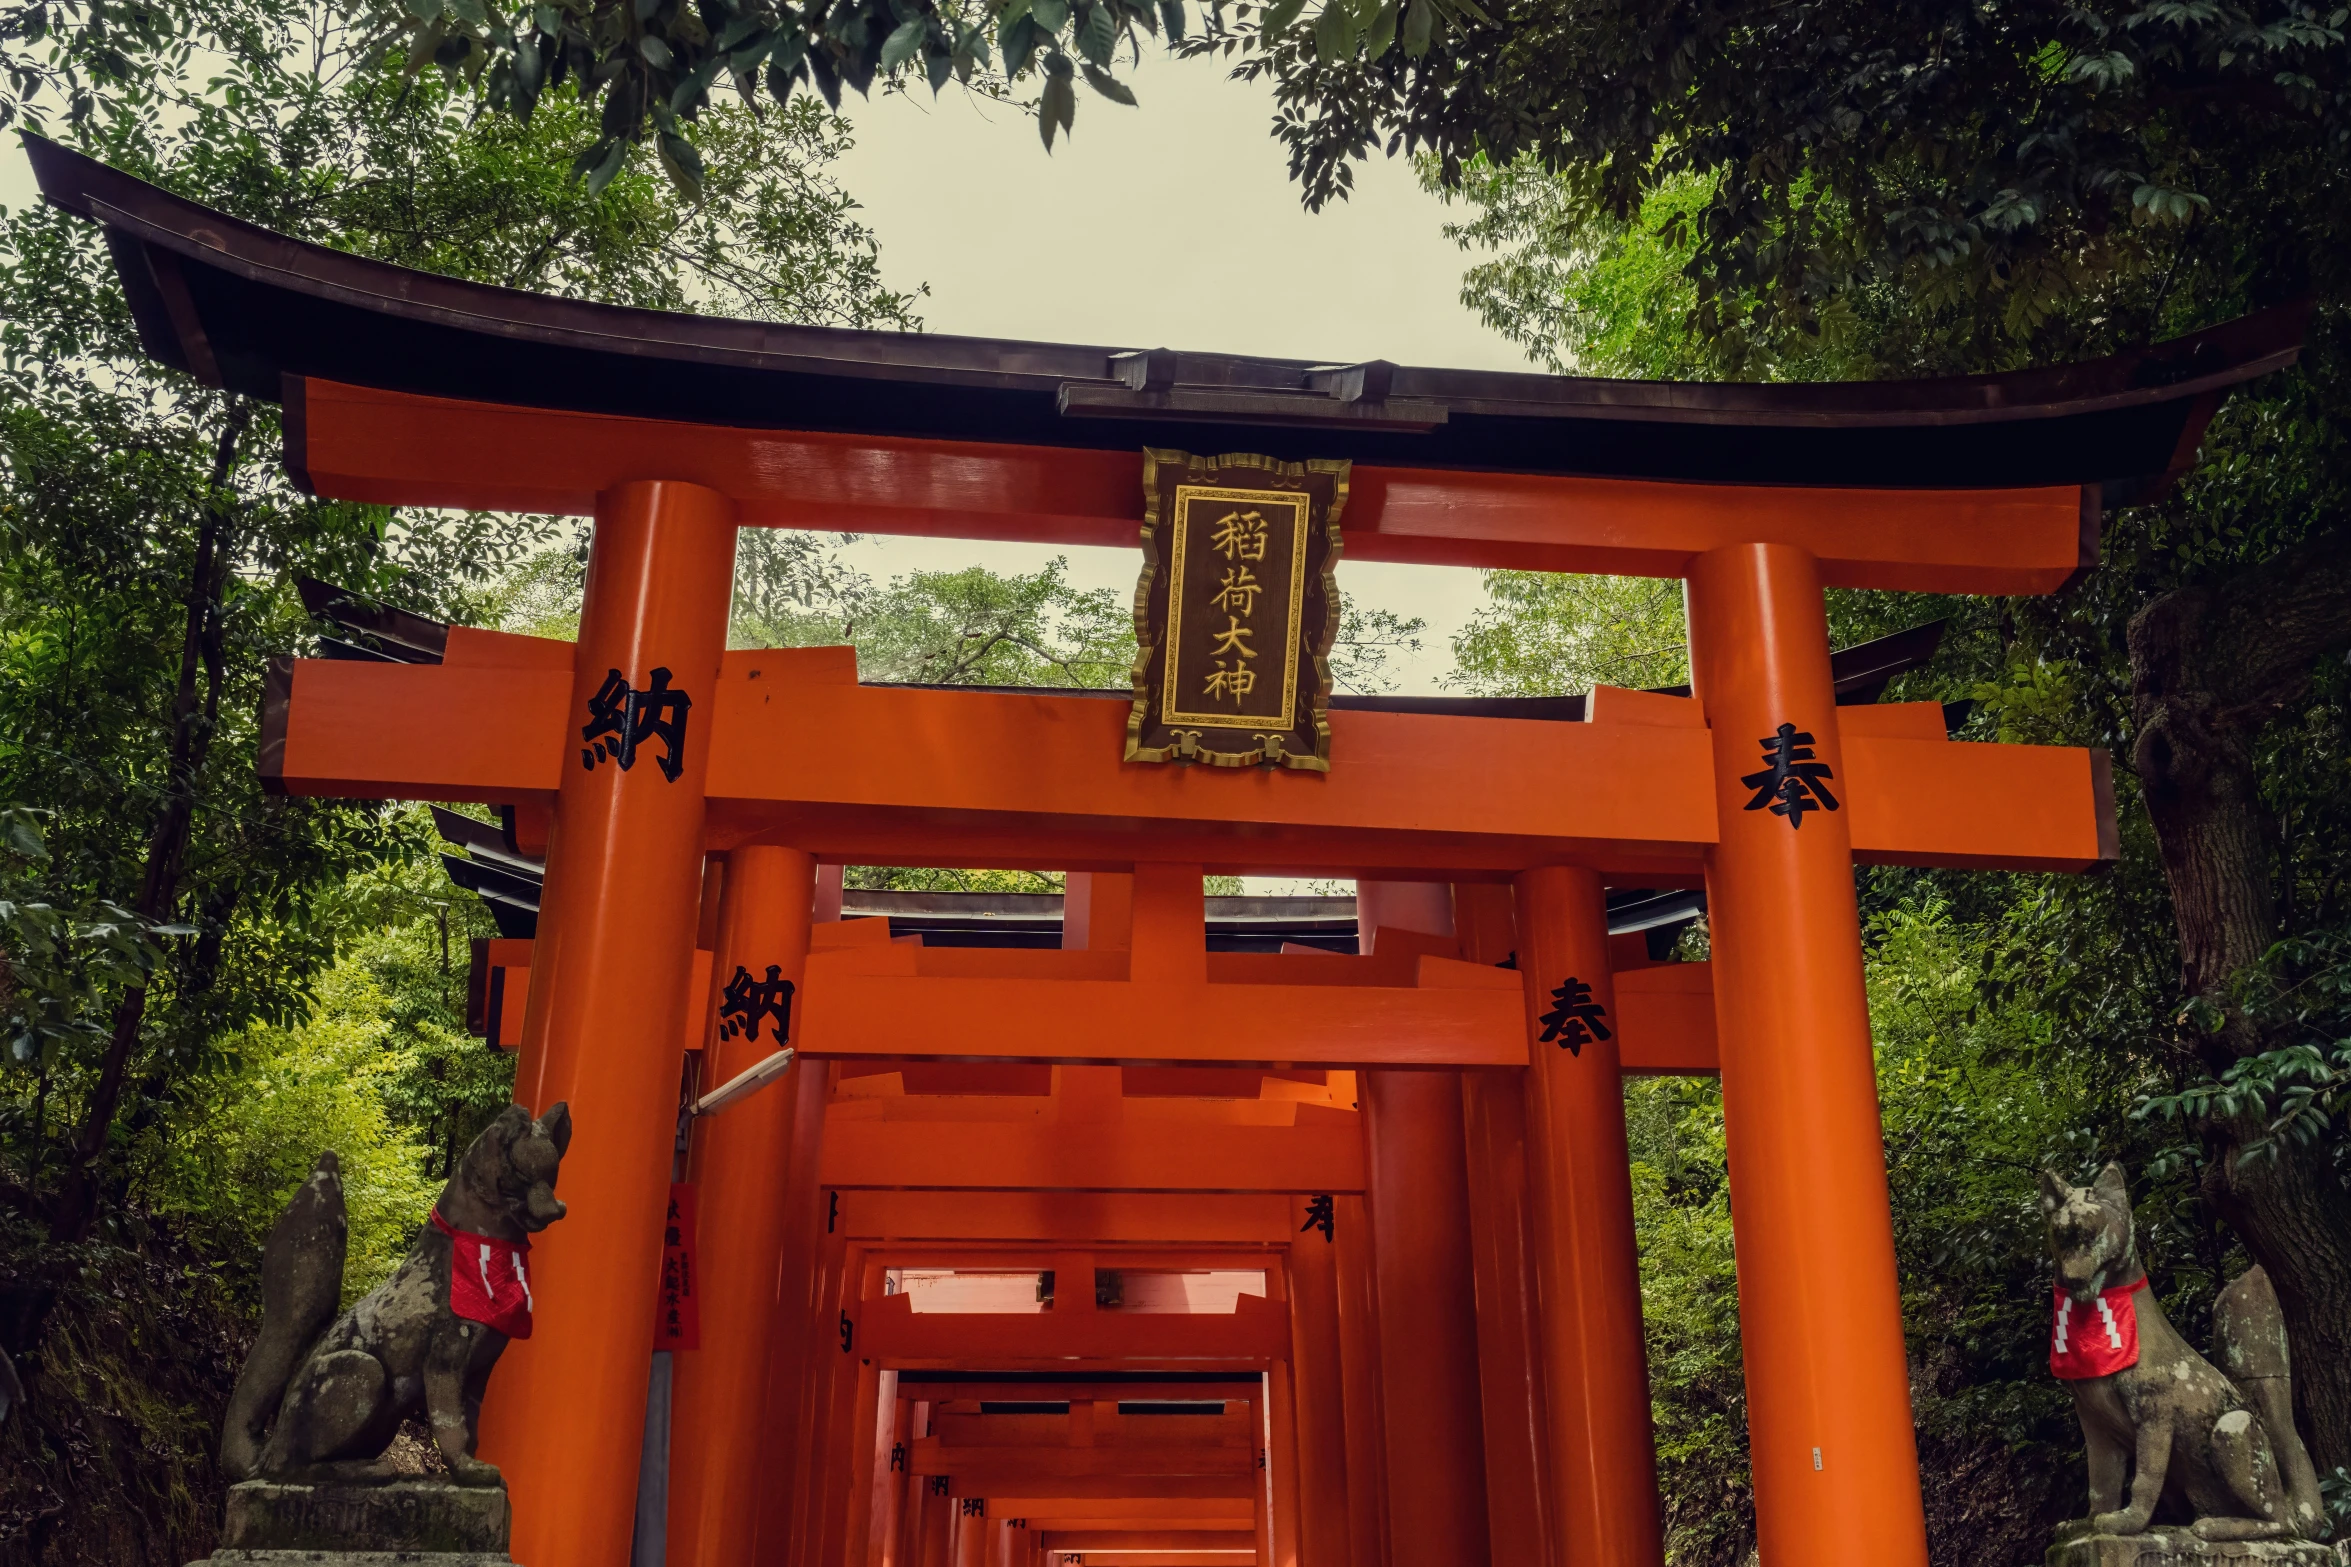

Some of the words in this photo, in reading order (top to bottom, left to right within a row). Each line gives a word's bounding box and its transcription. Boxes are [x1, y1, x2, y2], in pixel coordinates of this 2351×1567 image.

[581, 667, 692, 783] 納
[1740, 722, 1839, 830] 奉
[720, 965, 795, 1047] 納
[1538, 977, 1612, 1057] 奉
